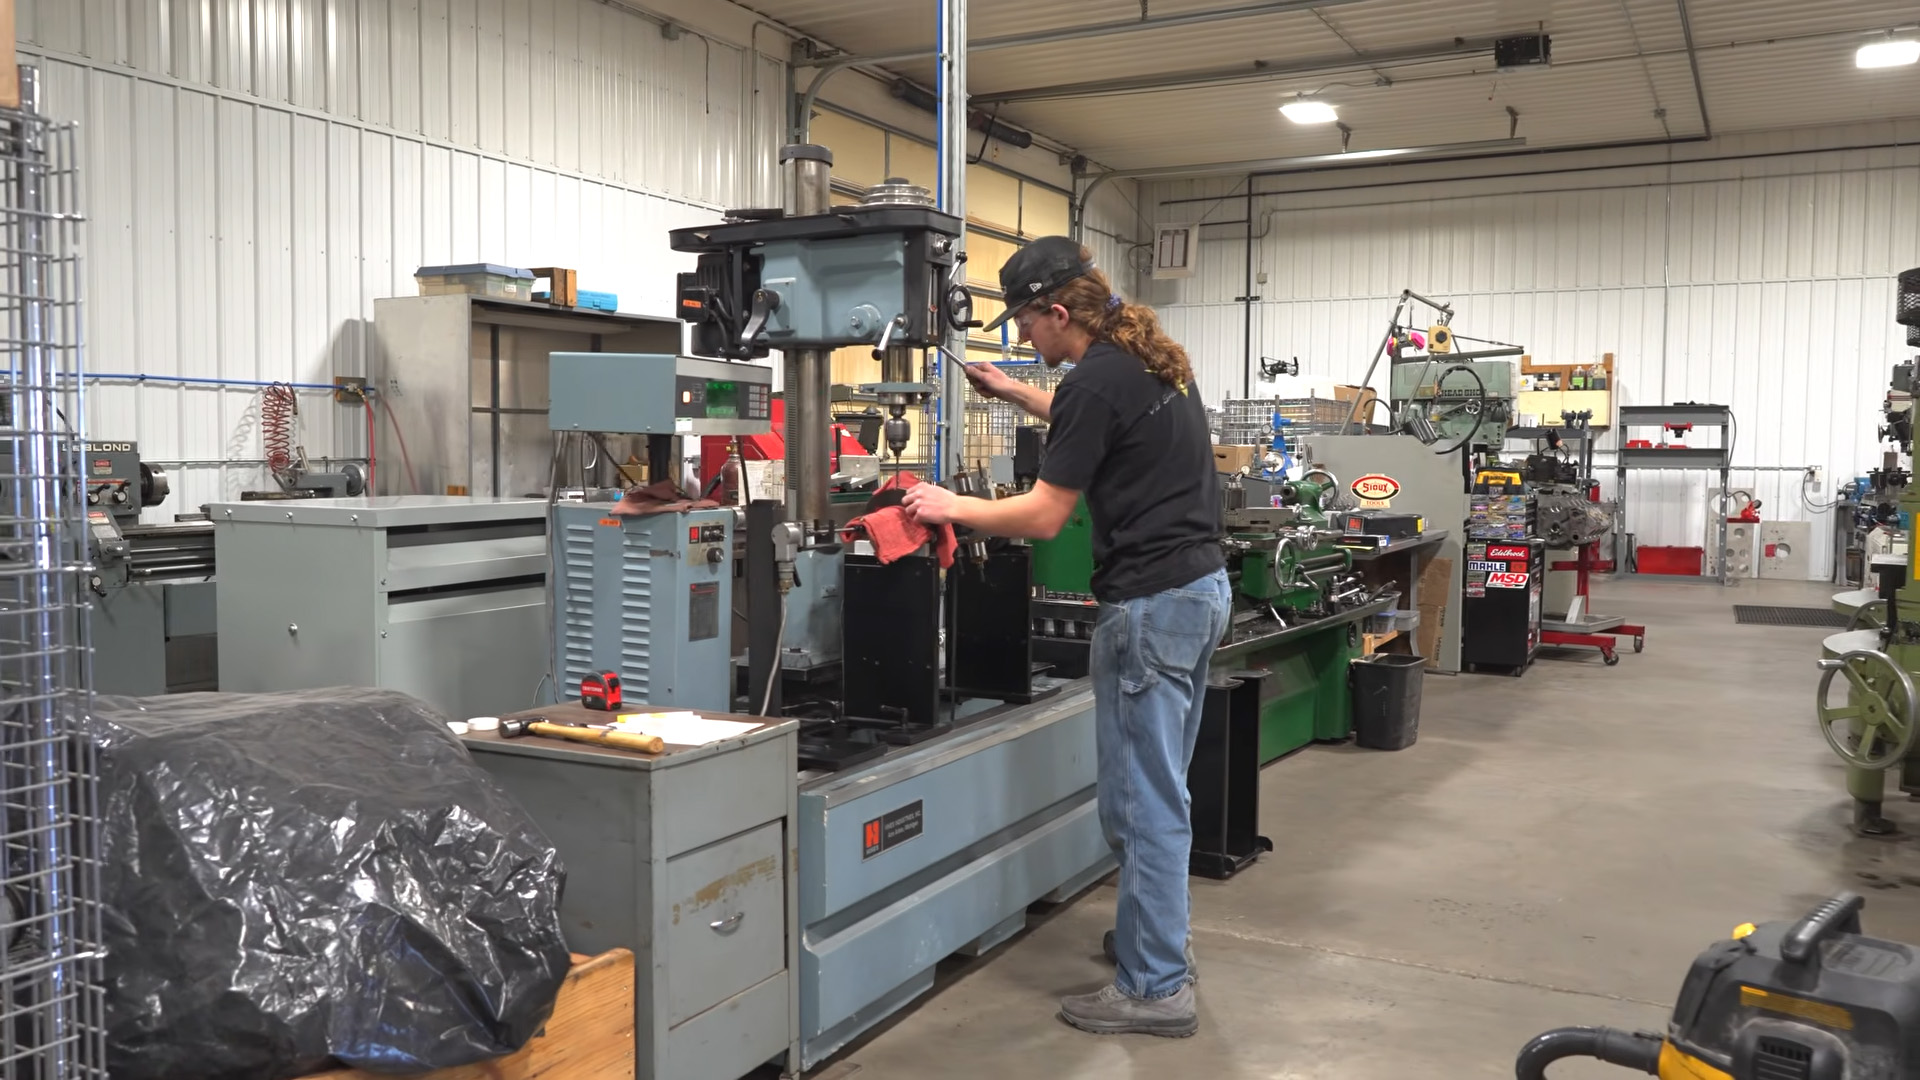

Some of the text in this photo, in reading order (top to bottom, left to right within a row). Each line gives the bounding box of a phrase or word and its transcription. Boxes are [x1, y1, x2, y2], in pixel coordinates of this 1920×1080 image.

[1490, 548, 1525, 557] Edelbrock
[1469, 562, 1505, 571] MAHLE
[1490, 573, 1527, 584] MSD
